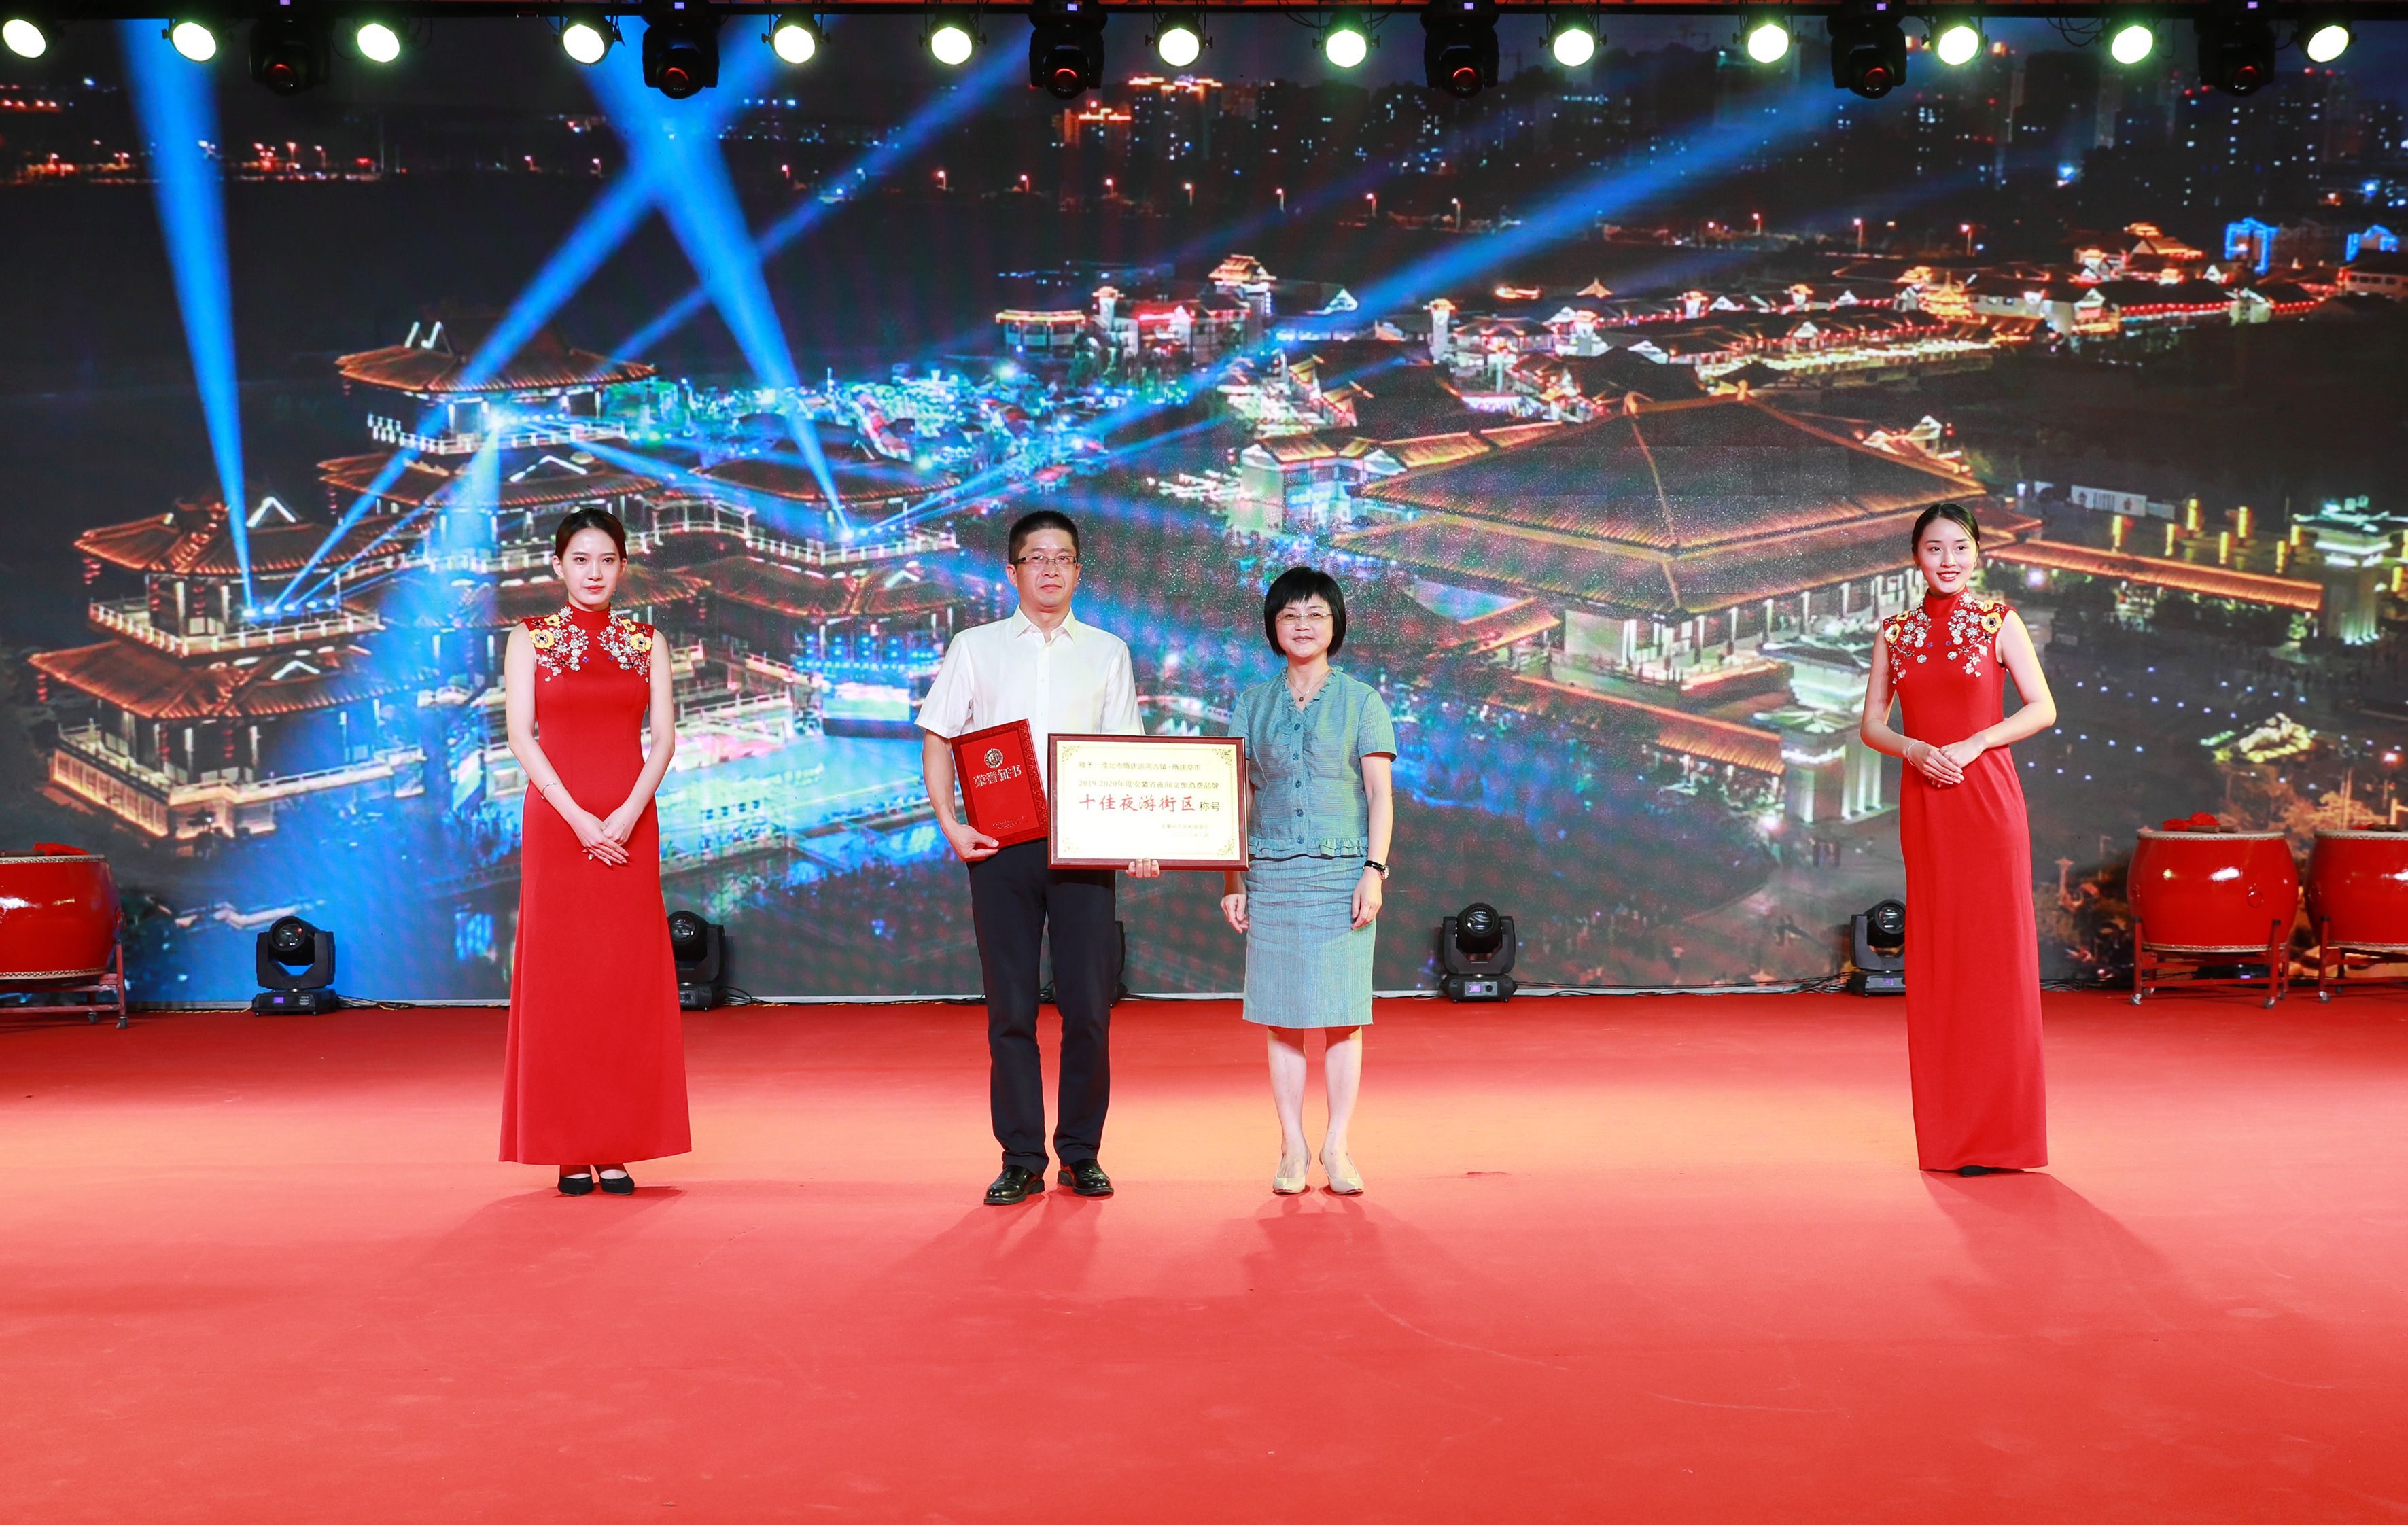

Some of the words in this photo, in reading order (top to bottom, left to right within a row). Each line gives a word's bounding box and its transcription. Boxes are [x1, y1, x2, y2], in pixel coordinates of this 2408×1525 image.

[973, 765, 1022, 788] 荣誉证书
[1079, 794, 1196, 812] 十佳夜游街区
[1200, 801, 1220, 812] 称号
